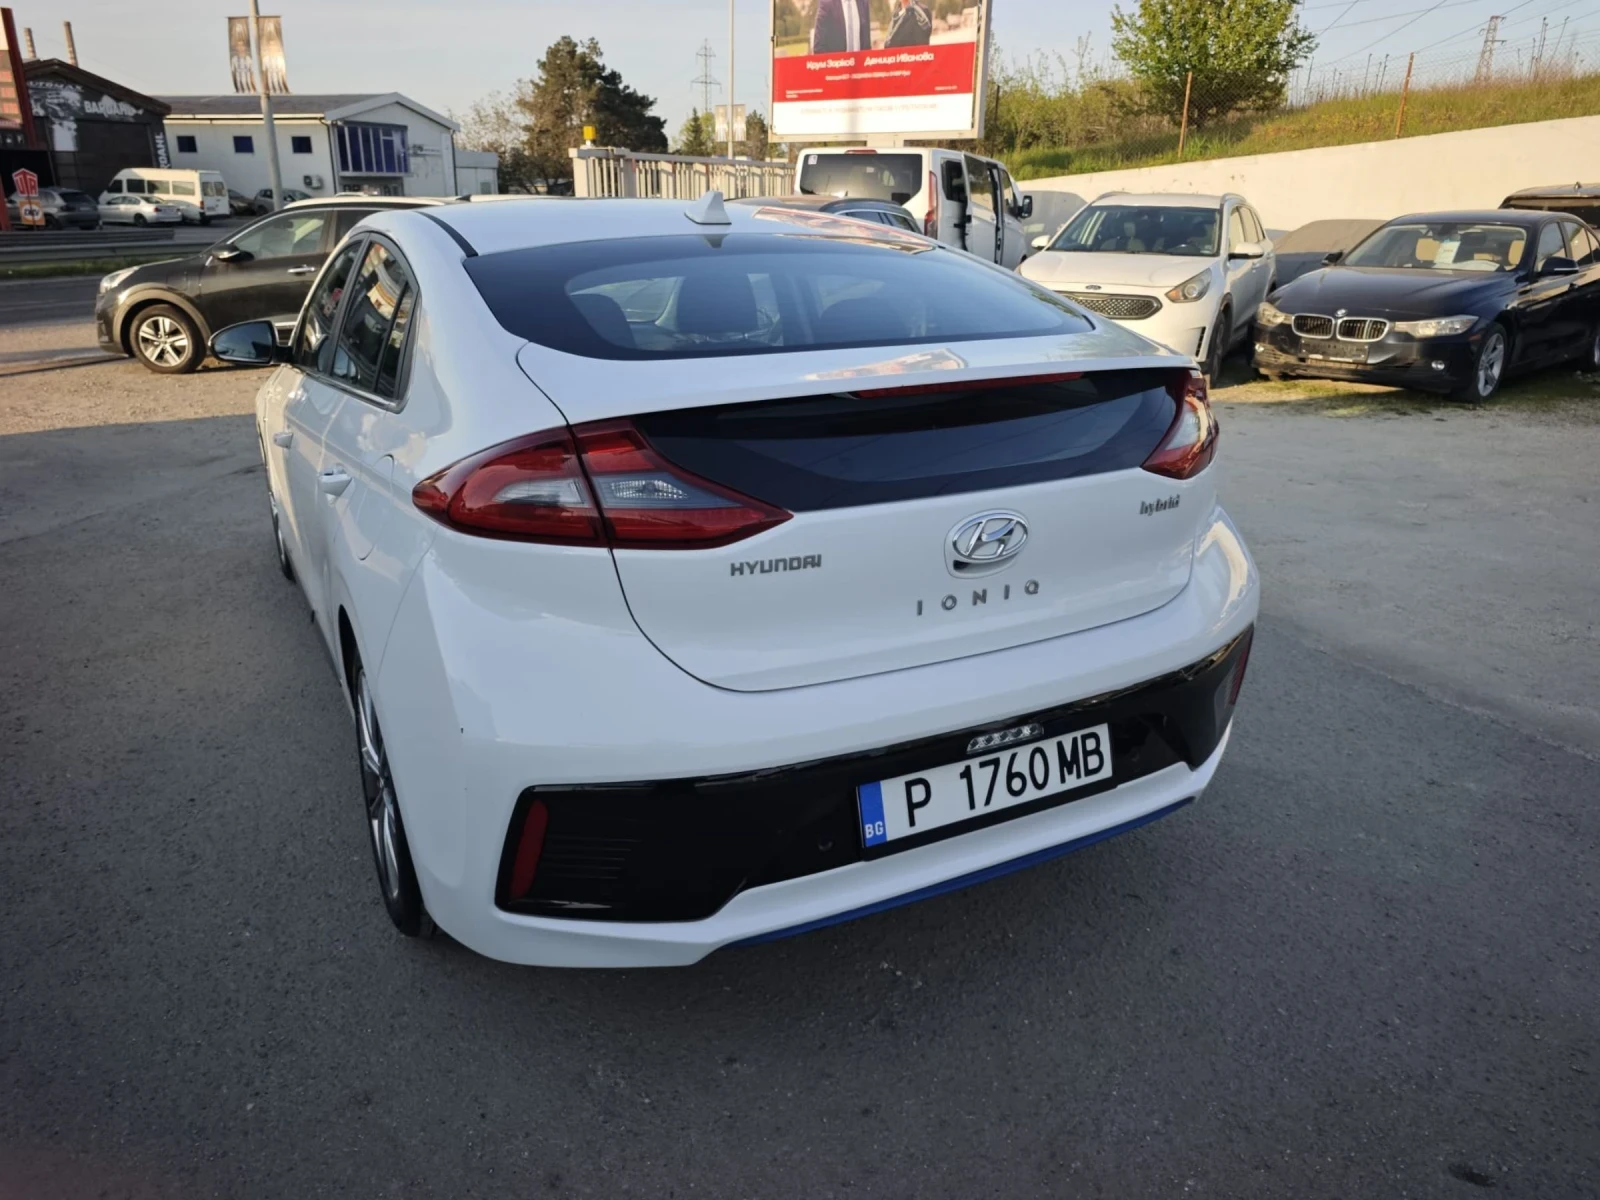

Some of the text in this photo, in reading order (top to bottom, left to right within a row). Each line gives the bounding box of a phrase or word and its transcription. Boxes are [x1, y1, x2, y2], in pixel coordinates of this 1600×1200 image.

[1139, 493, 1181, 517] hybrid
[730, 553, 822, 577] HYUNDAI
[916, 578, 1041, 617] IONIQ
[904, 730, 1106, 828] P 1760 MB
[864, 820, 885, 839] BG
